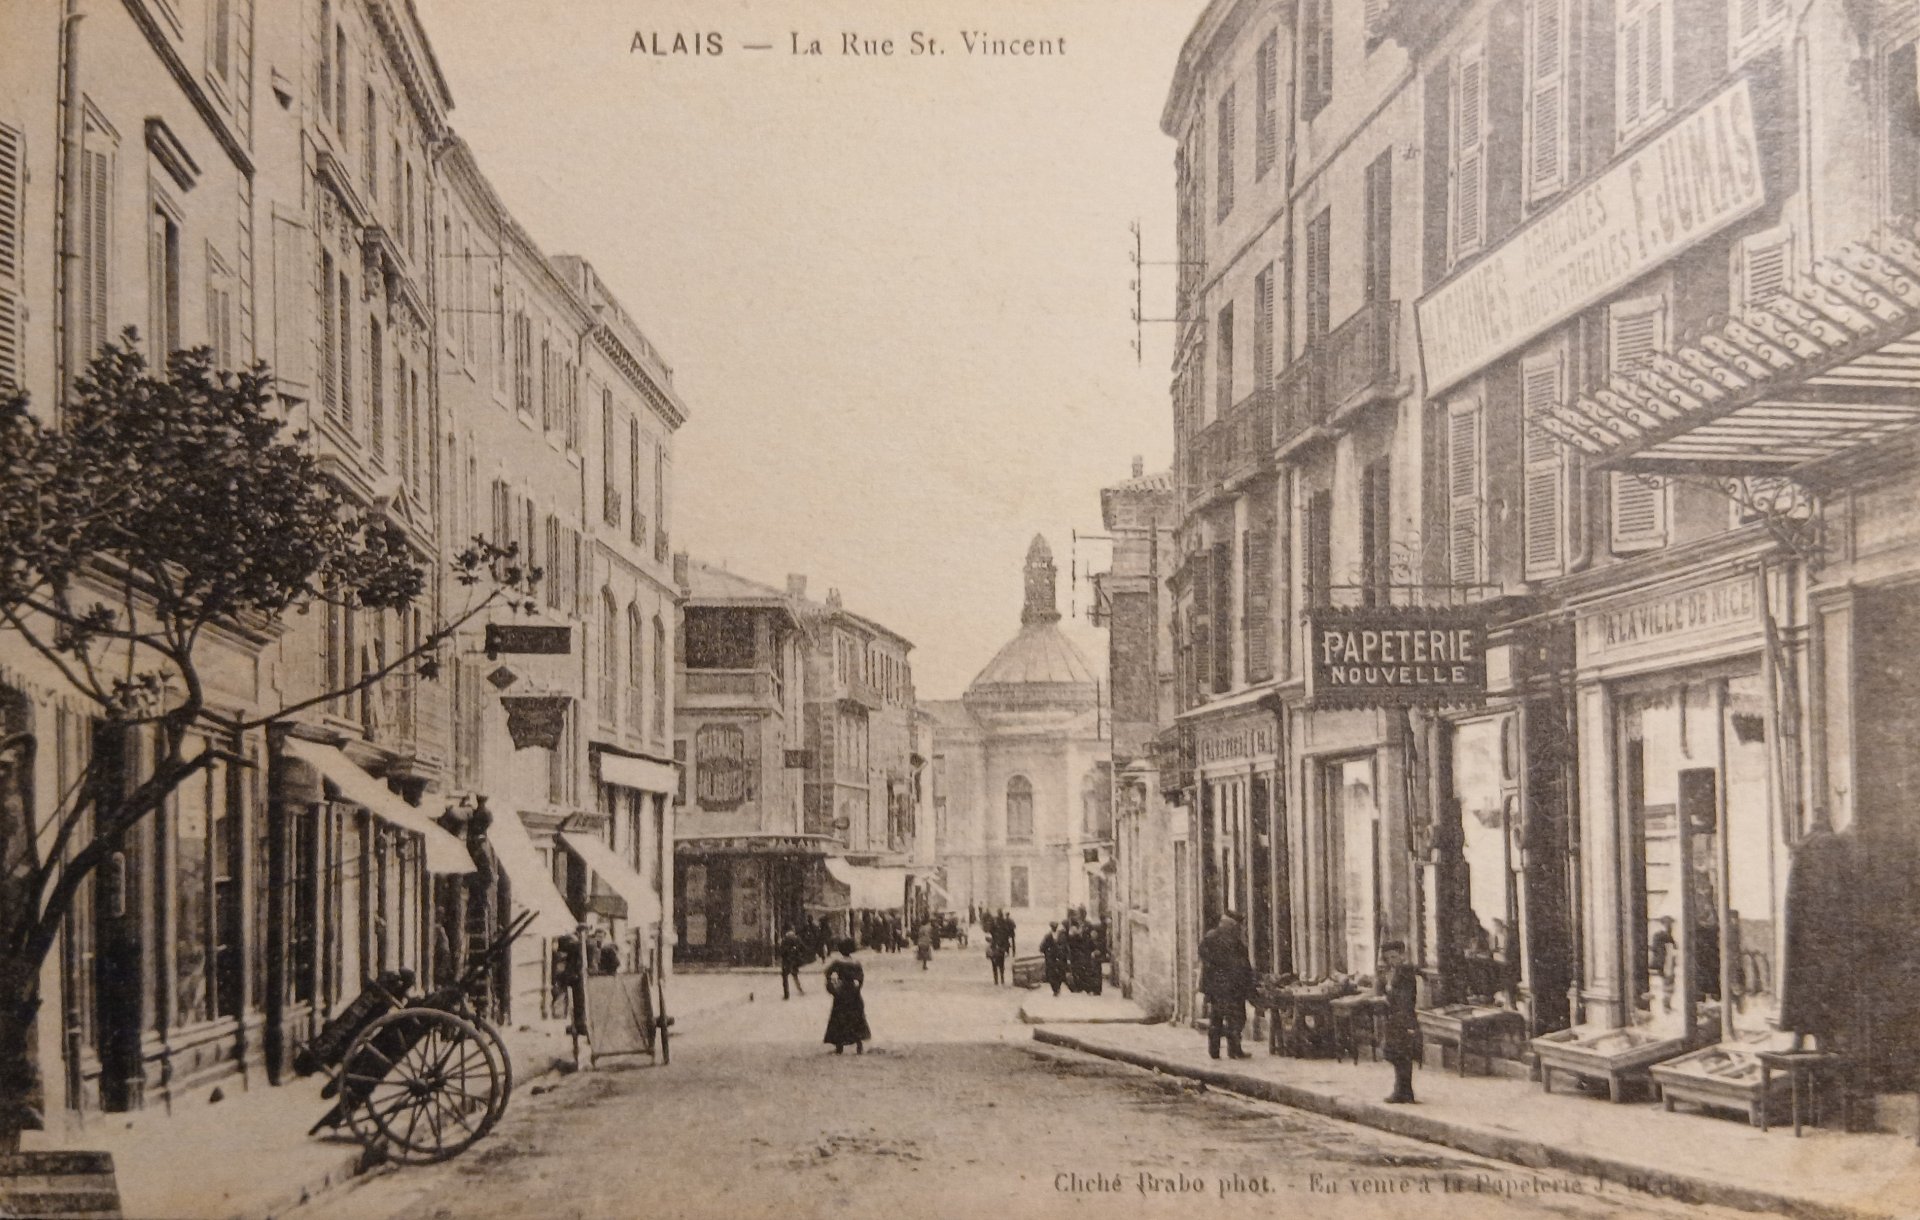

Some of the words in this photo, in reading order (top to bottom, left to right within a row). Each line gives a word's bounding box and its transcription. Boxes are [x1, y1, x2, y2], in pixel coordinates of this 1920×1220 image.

[1523, 182, 1606, 280] AGRICOLES
[1638, 598, 1684, 637] VILLE
[1687, 590, 1707, 626] DE
[1323, 629, 1474, 664] PAPETERIE
[1331, 666, 1466, 685] NOUVELLE
